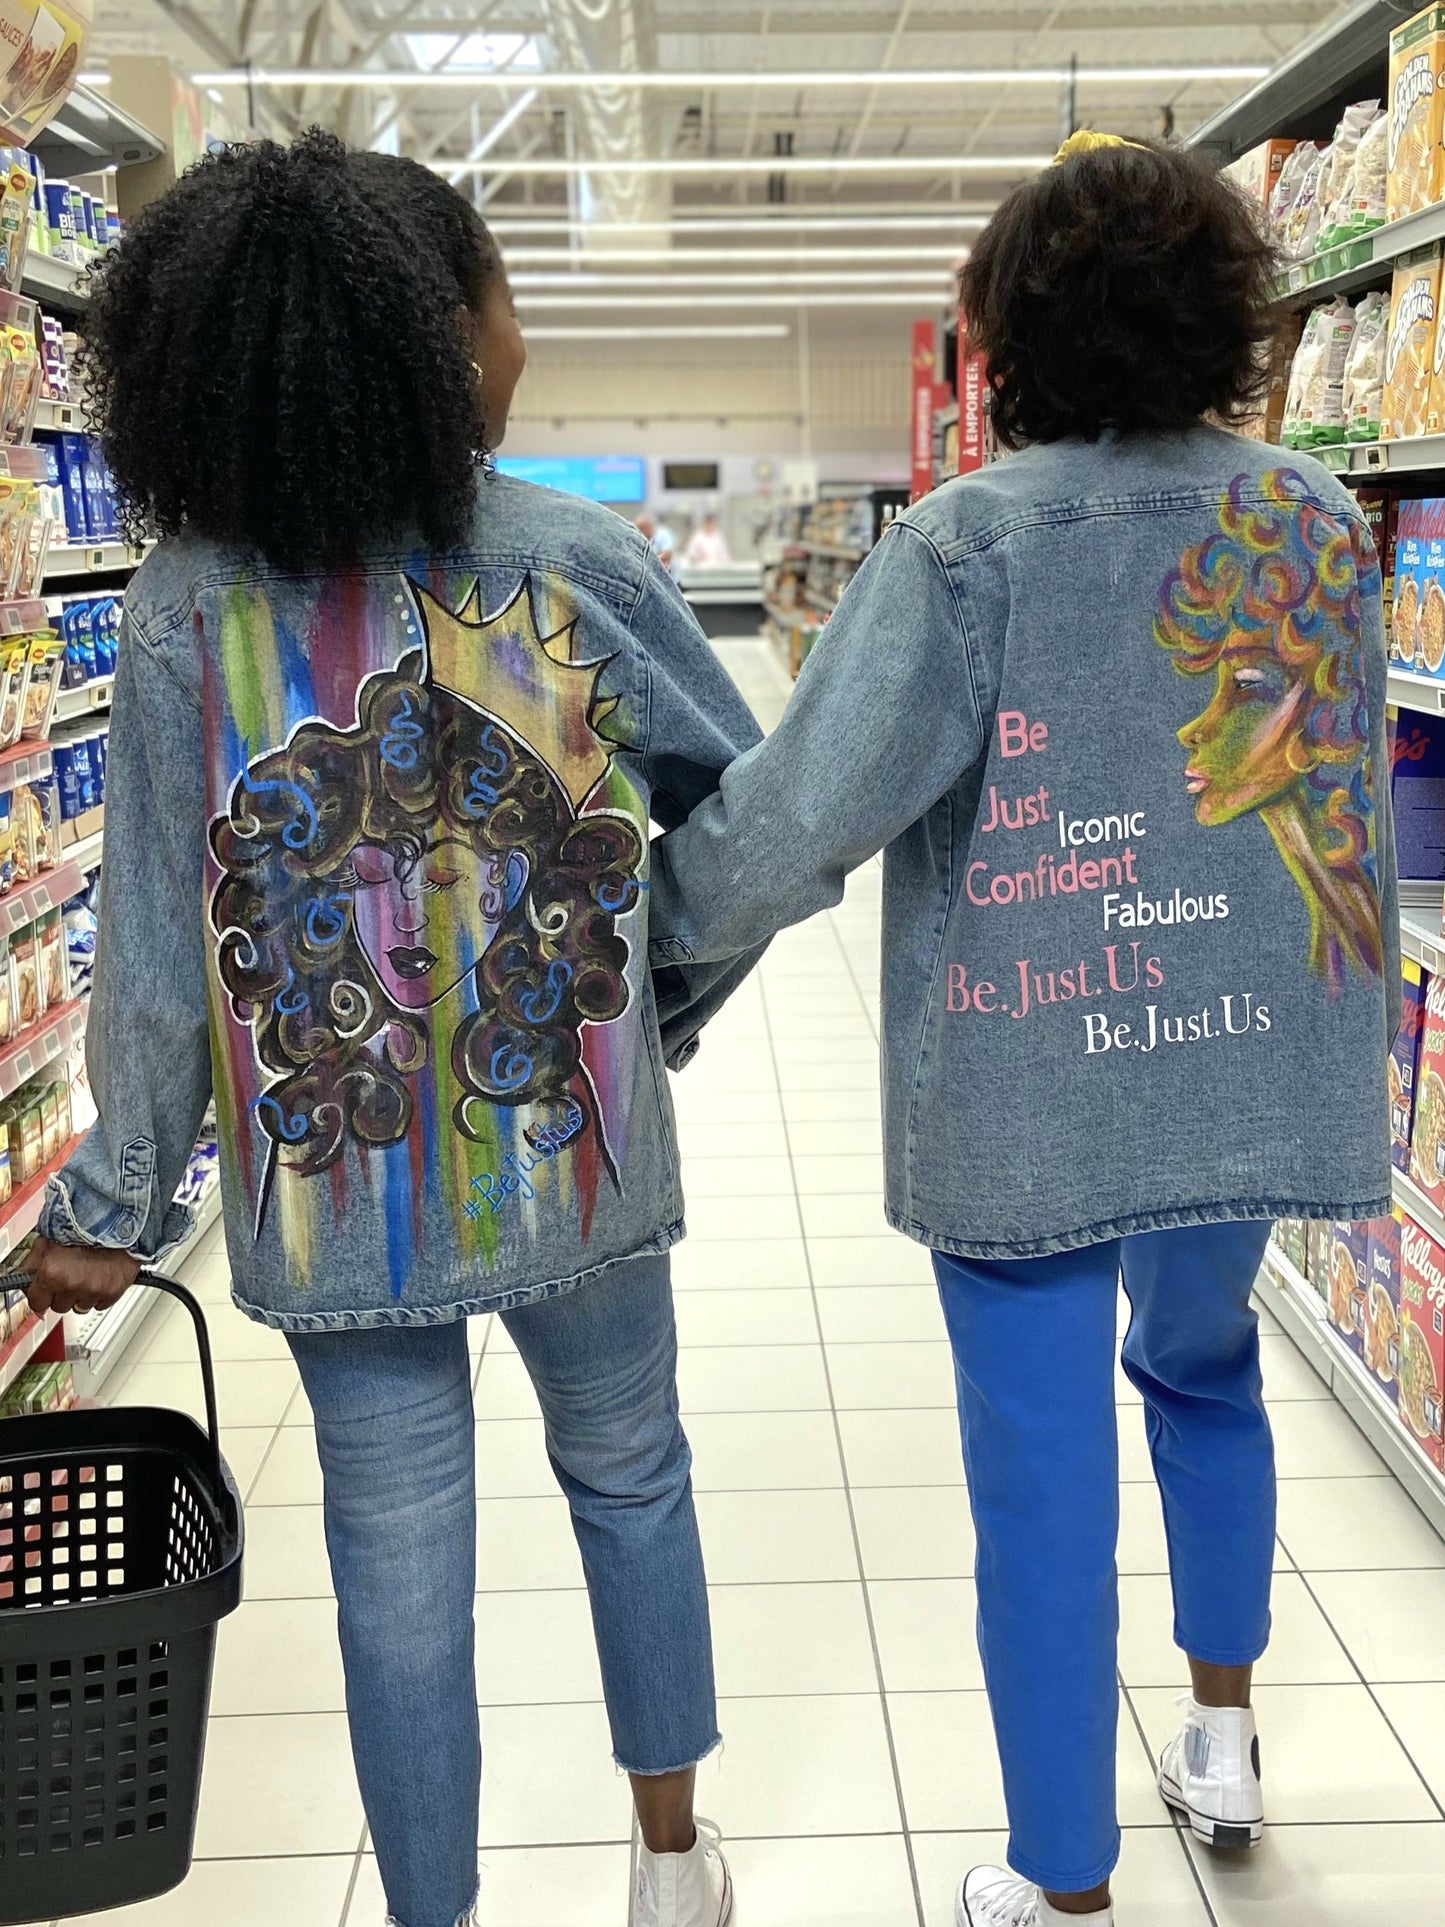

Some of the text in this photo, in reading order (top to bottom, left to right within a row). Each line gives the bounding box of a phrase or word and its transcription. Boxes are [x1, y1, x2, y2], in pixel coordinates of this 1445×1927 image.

[963, 447, 978, 457] À
[998, 711, 1048, 759] Be
[981, 785, 1050, 833] Just
[1058, 811, 1147, 848] Iconic
[965, 848, 1139, 906] Confident
[1102, 888, 1229, 931] Fabulous
[945, 941, 1165, 1019] Be.Just.Us
[1081, 993, 1272, 1055] Be.Just.Us
